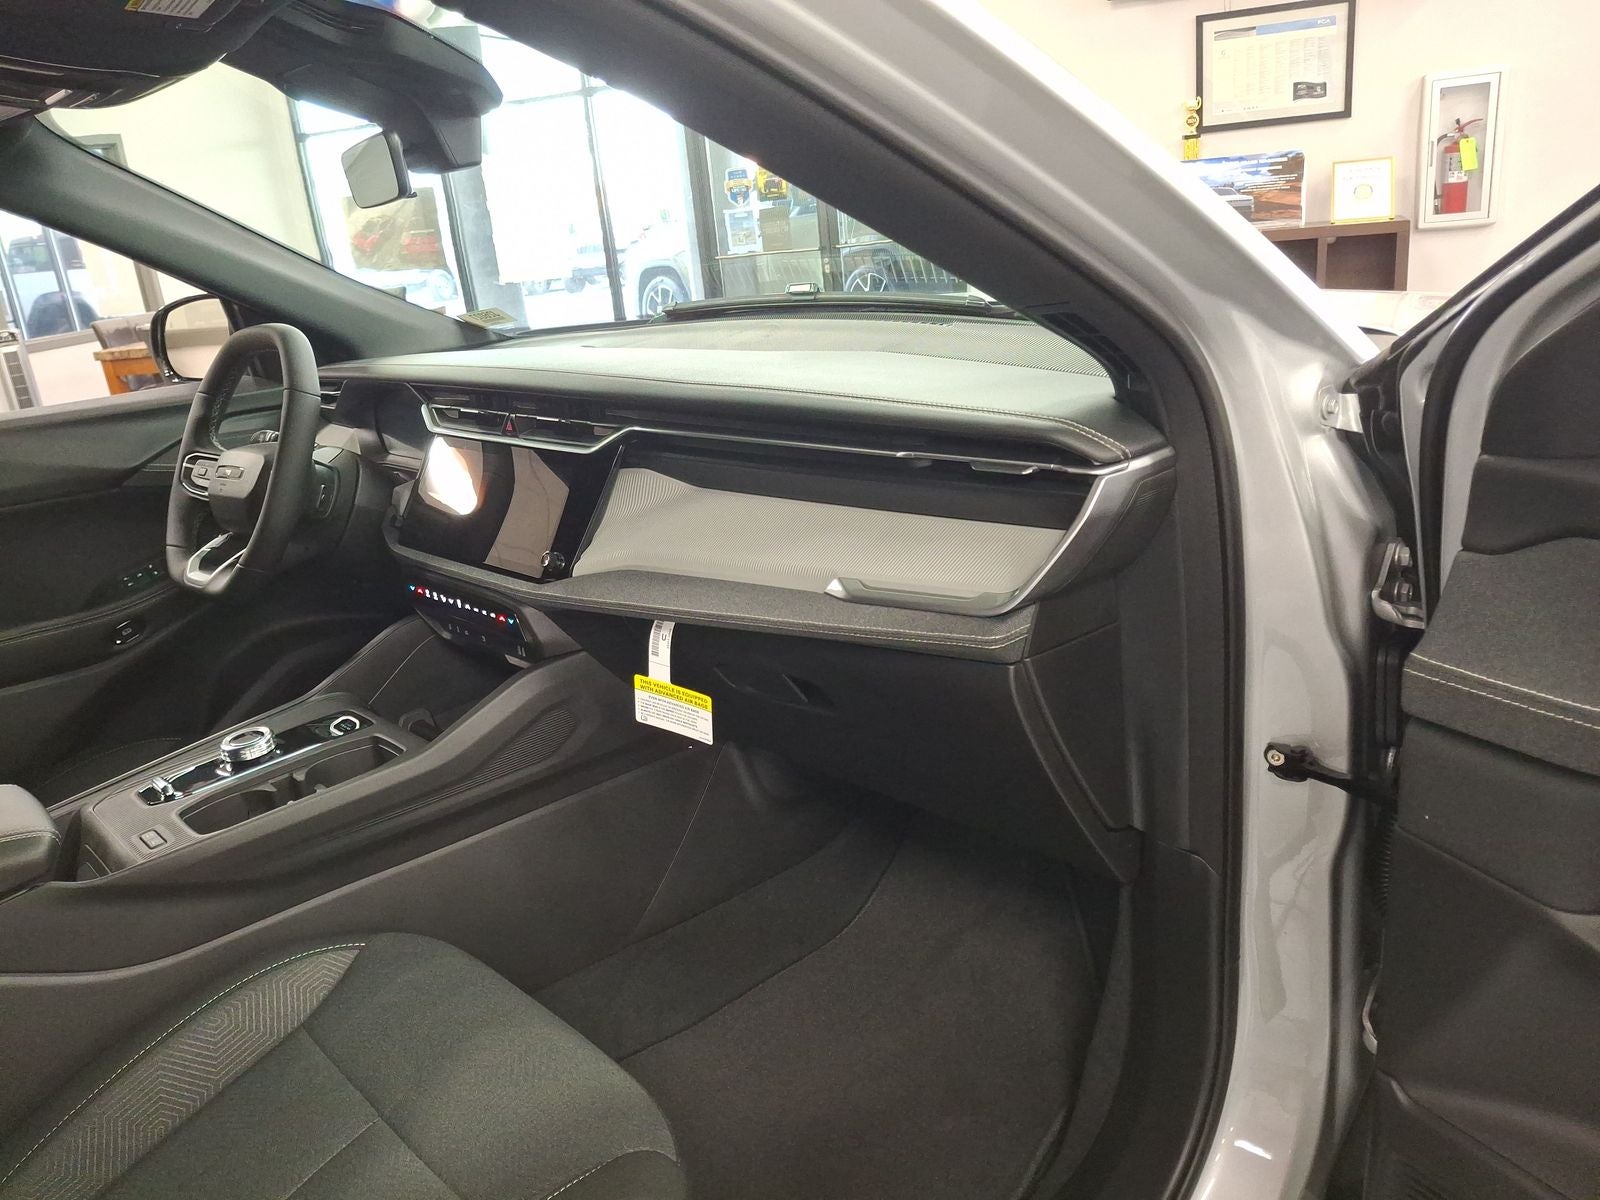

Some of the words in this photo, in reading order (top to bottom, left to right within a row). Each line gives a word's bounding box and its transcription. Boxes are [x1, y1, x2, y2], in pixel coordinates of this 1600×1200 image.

[640, 679, 652, 687] THIS
[653, 682, 675, 693] VEHICLE
[682, 690, 708, 704] EQUIPPED
[640, 684, 654, 692] WITH
[655, 688, 684, 701] ADVANCED
[694, 700, 708, 710] BAGS
